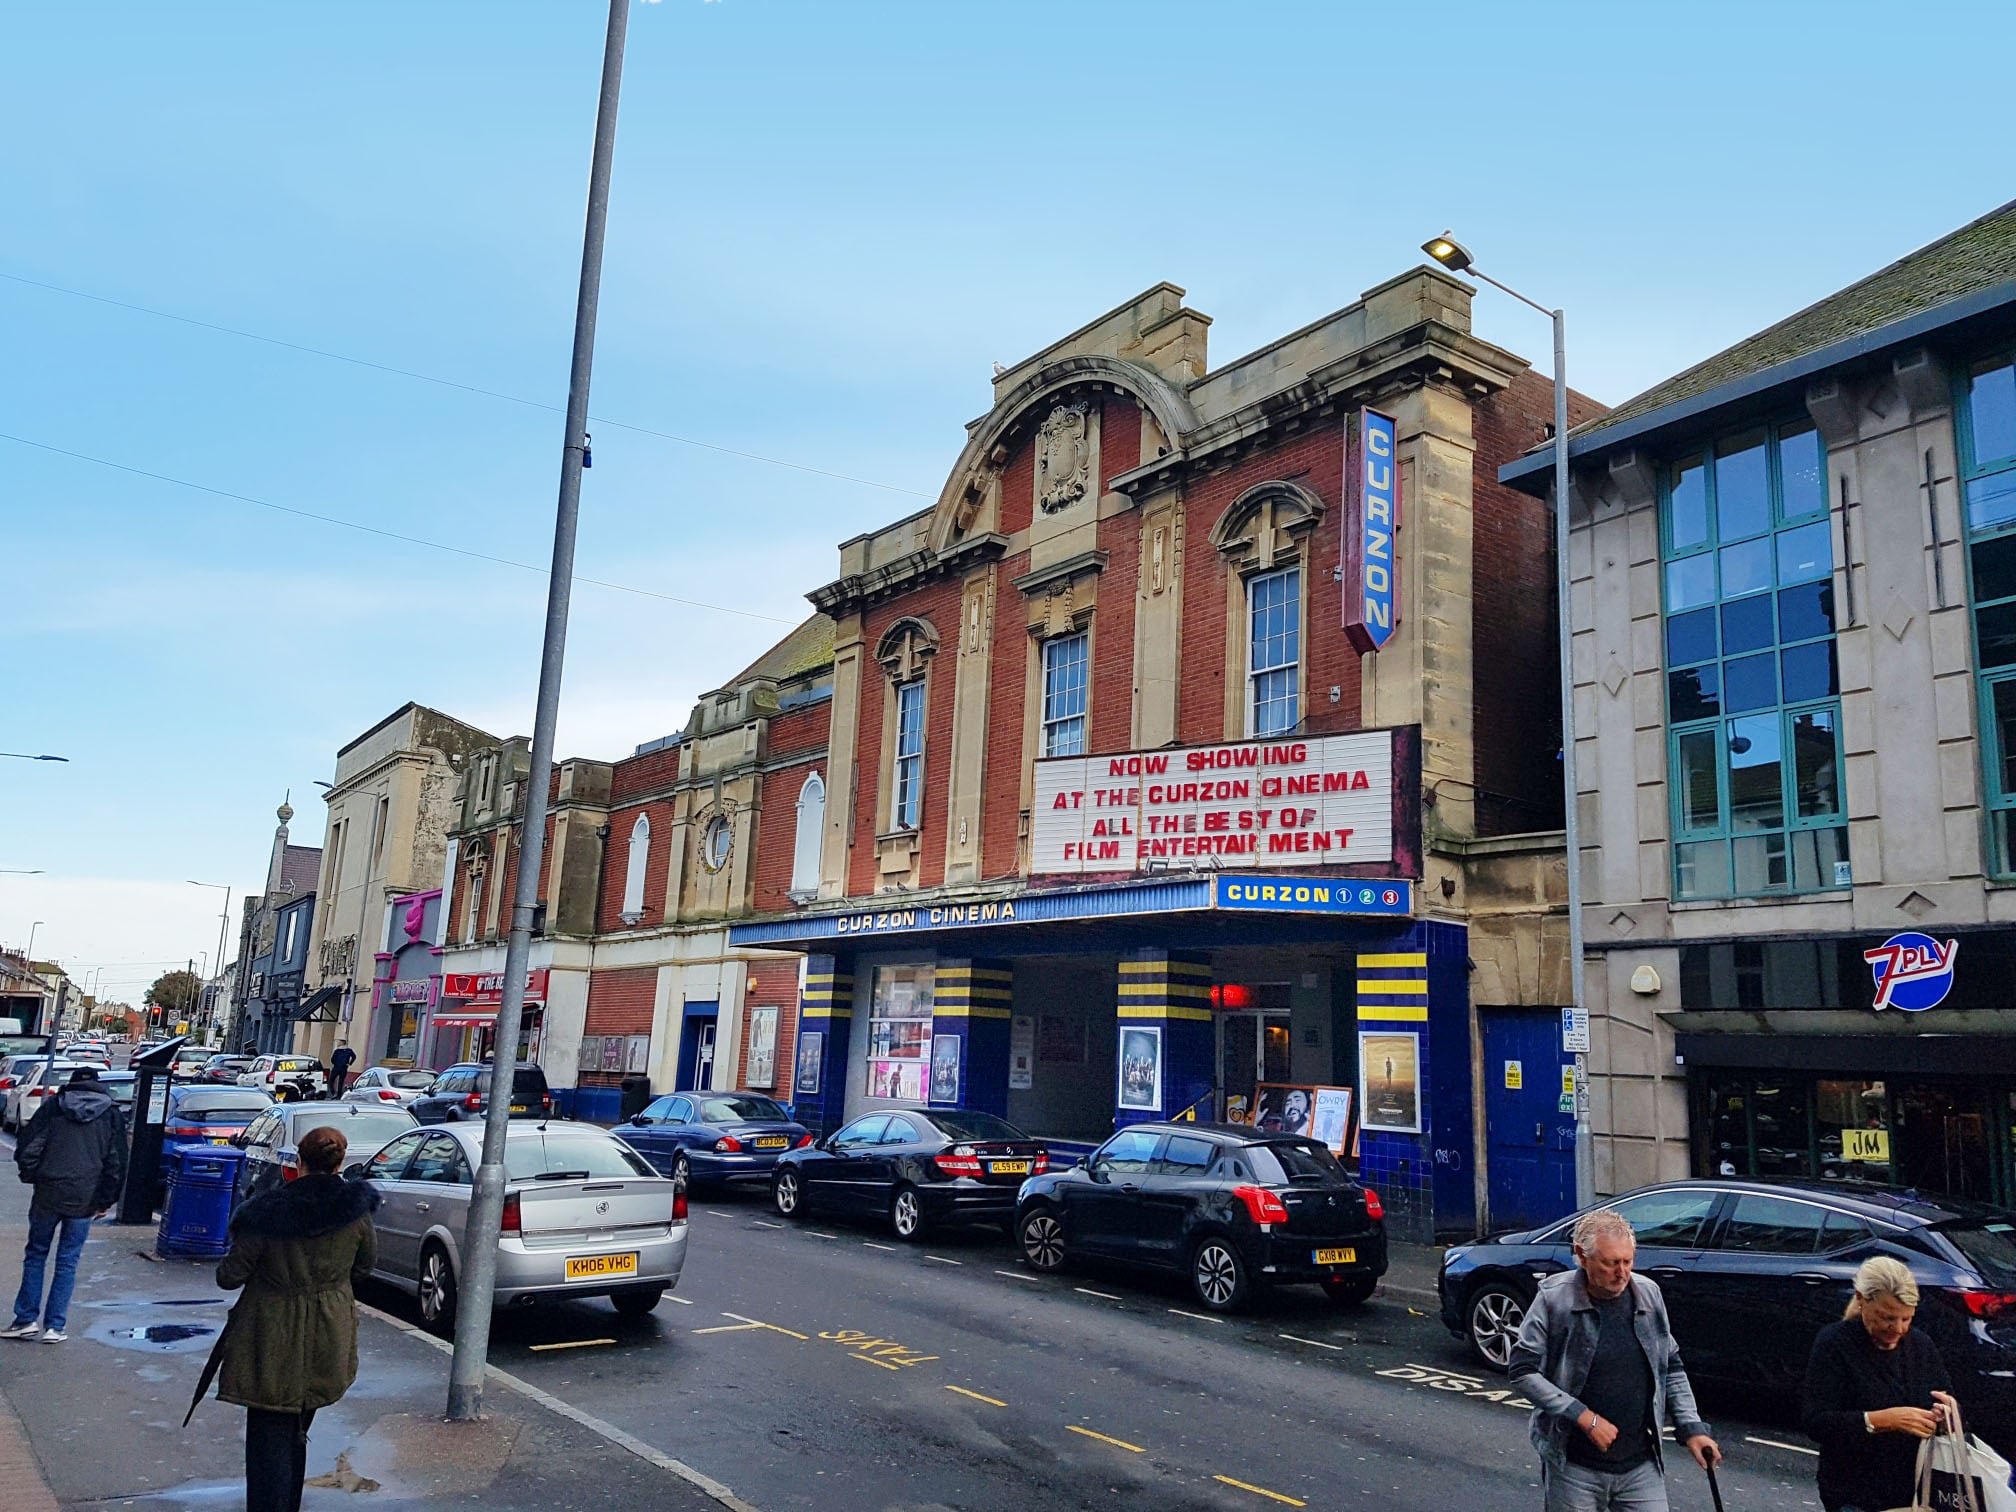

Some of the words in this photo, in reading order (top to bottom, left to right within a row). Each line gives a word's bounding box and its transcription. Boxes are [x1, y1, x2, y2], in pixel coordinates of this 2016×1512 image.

[1366, 428, 1389, 629] CURZON
[1109, 755, 1169, 776] NOW
[1187, 743, 1307, 771] SHOWING
[1053, 791, 1084, 809] AT
[1094, 788, 1139, 807] THE
[1148, 780, 1248, 804] CURZON
[1262, 770, 1370, 797] CINEMA
[1093, 818, 1133, 837] ALL
[1148, 815, 1197, 833] THE
[1280, 807, 1317, 828] OF
[1064, 840, 1119, 861] FILM
[1228, 885, 1329, 903] CURZON
[837, 911, 915, 932] CURZON
[930, 902, 1016, 924] CINEMA
[279, 1061, 296, 1071] JM
[1317, 1094, 1346, 1106] OWRY
[1560, 1094, 1574, 1102] Fir
[1853, 1131, 1880, 1156] JM
[992, 1162, 1011, 1171] GL59
[1012, 1162, 1025, 1171] EWP
[572, 1258, 604, 1273] KH06
[608, 1256, 631, 1270] VHG
[1319, 1250, 1336, 1262] GX18
